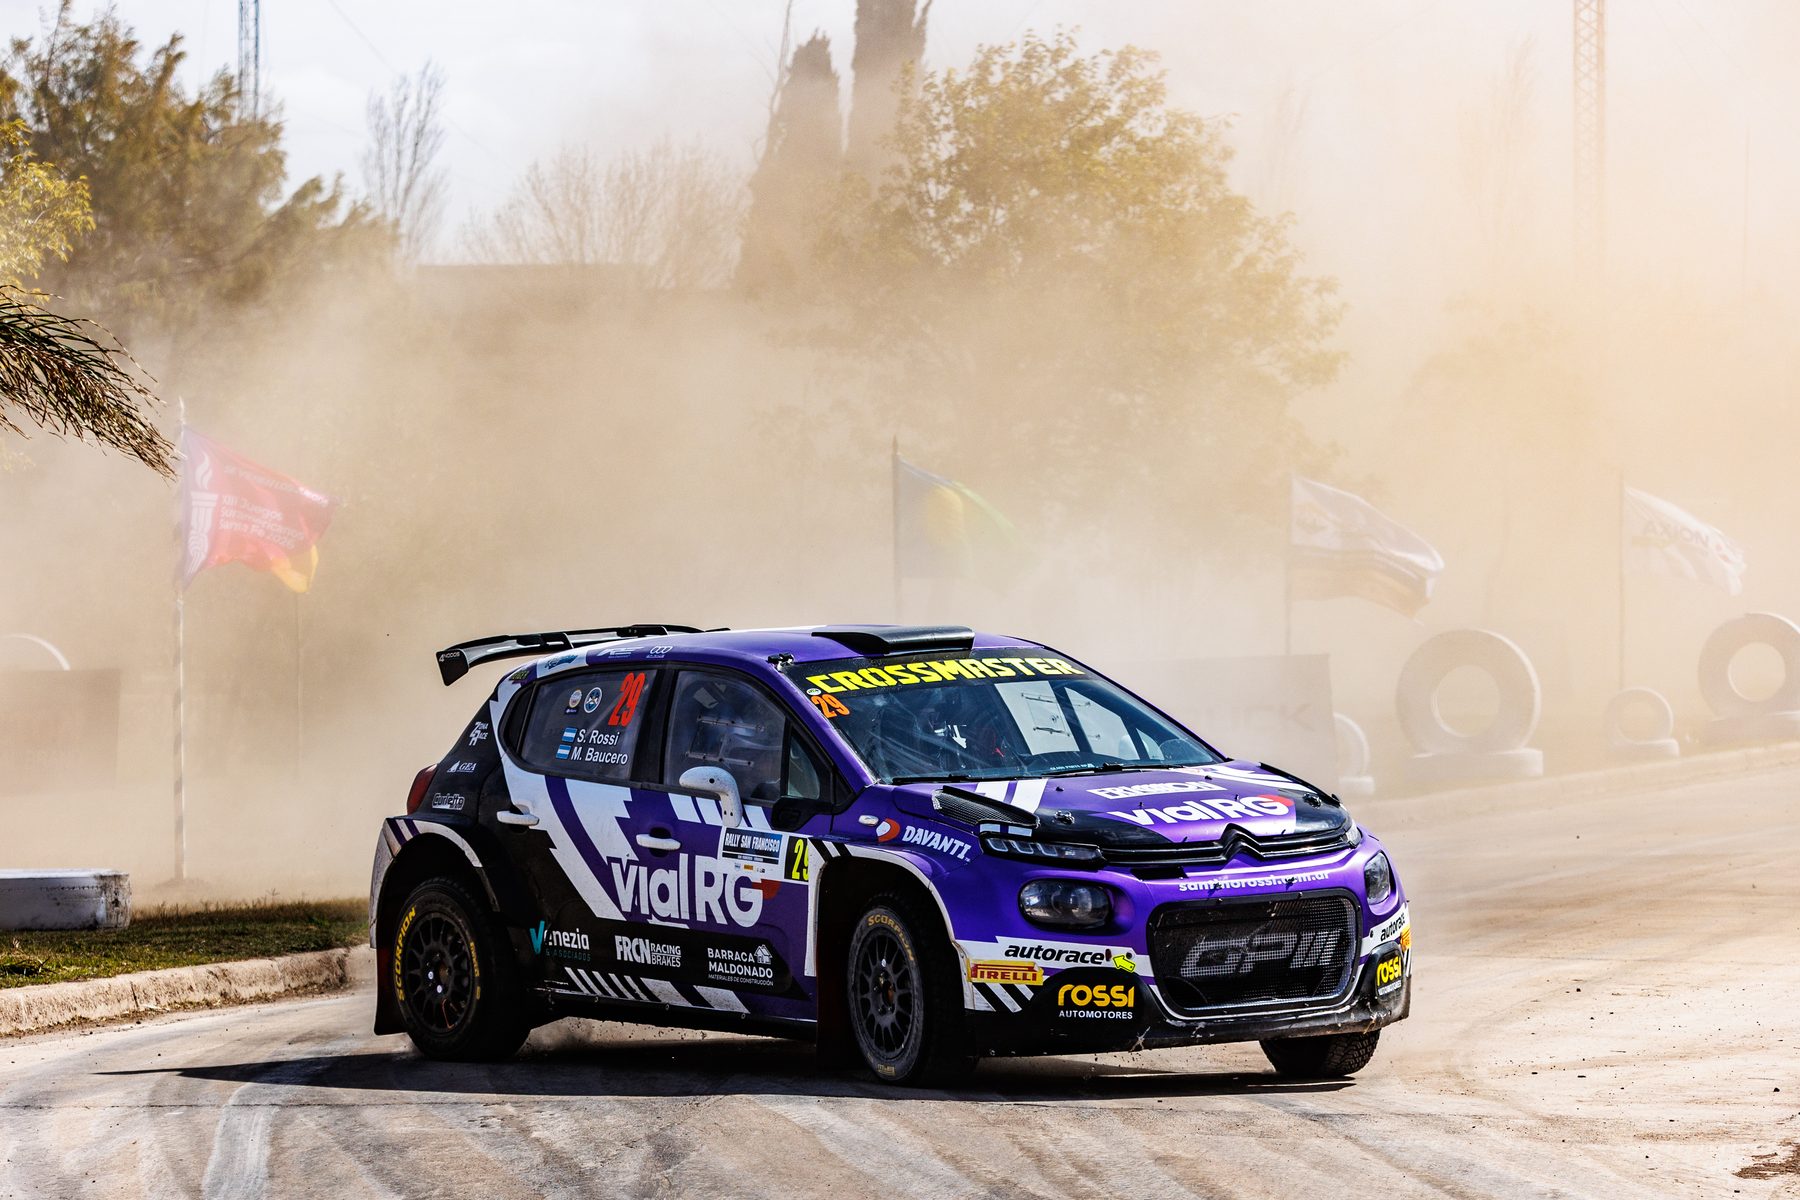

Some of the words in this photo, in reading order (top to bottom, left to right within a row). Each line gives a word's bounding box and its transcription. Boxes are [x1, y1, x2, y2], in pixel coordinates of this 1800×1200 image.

[239, 497, 284, 521] Juegos
[1642, 520, 1710, 549] AXION
[805, 657, 1086, 694] CROSSMASTER
[607, 671, 646, 727] 29
[810, 693, 850, 719] 29
[577, 729, 586, 743] S.
[589, 729, 620, 746] Rossi
[570, 746, 582, 761] M.
[585, 747, 628, 765] Baucero
[459, 762, 477, 771] GEA
[725, 832, 741, 847] RALLY
[741, 835, 752, 848] SAN
[751, 836, 780, 852] FRANCISCO
[901, 825, 972, 860] DAVANTI
[1178, 871, 1330, 892] santnorossi.cm.ar
[395, 904, 416, 1001] SCORPION
[552, 950, 591, 962] ASOCIADOS
[614, 935, 651, 964] FRCN
[650, 943, 681, 955] RACING
[707, 947, 756, 963] BARRACA
[1004, 944, 1105, 965] autorace
[651, 955, 681, 968] BRAKES
[708, 961, 773, 979] MALDONADO
[708, 974, 733, 982] MATERIALES
[970, 964, 1037, 982] PIRELLI
[1058, 1010, 1133, 1020] AUTOMOTORES
